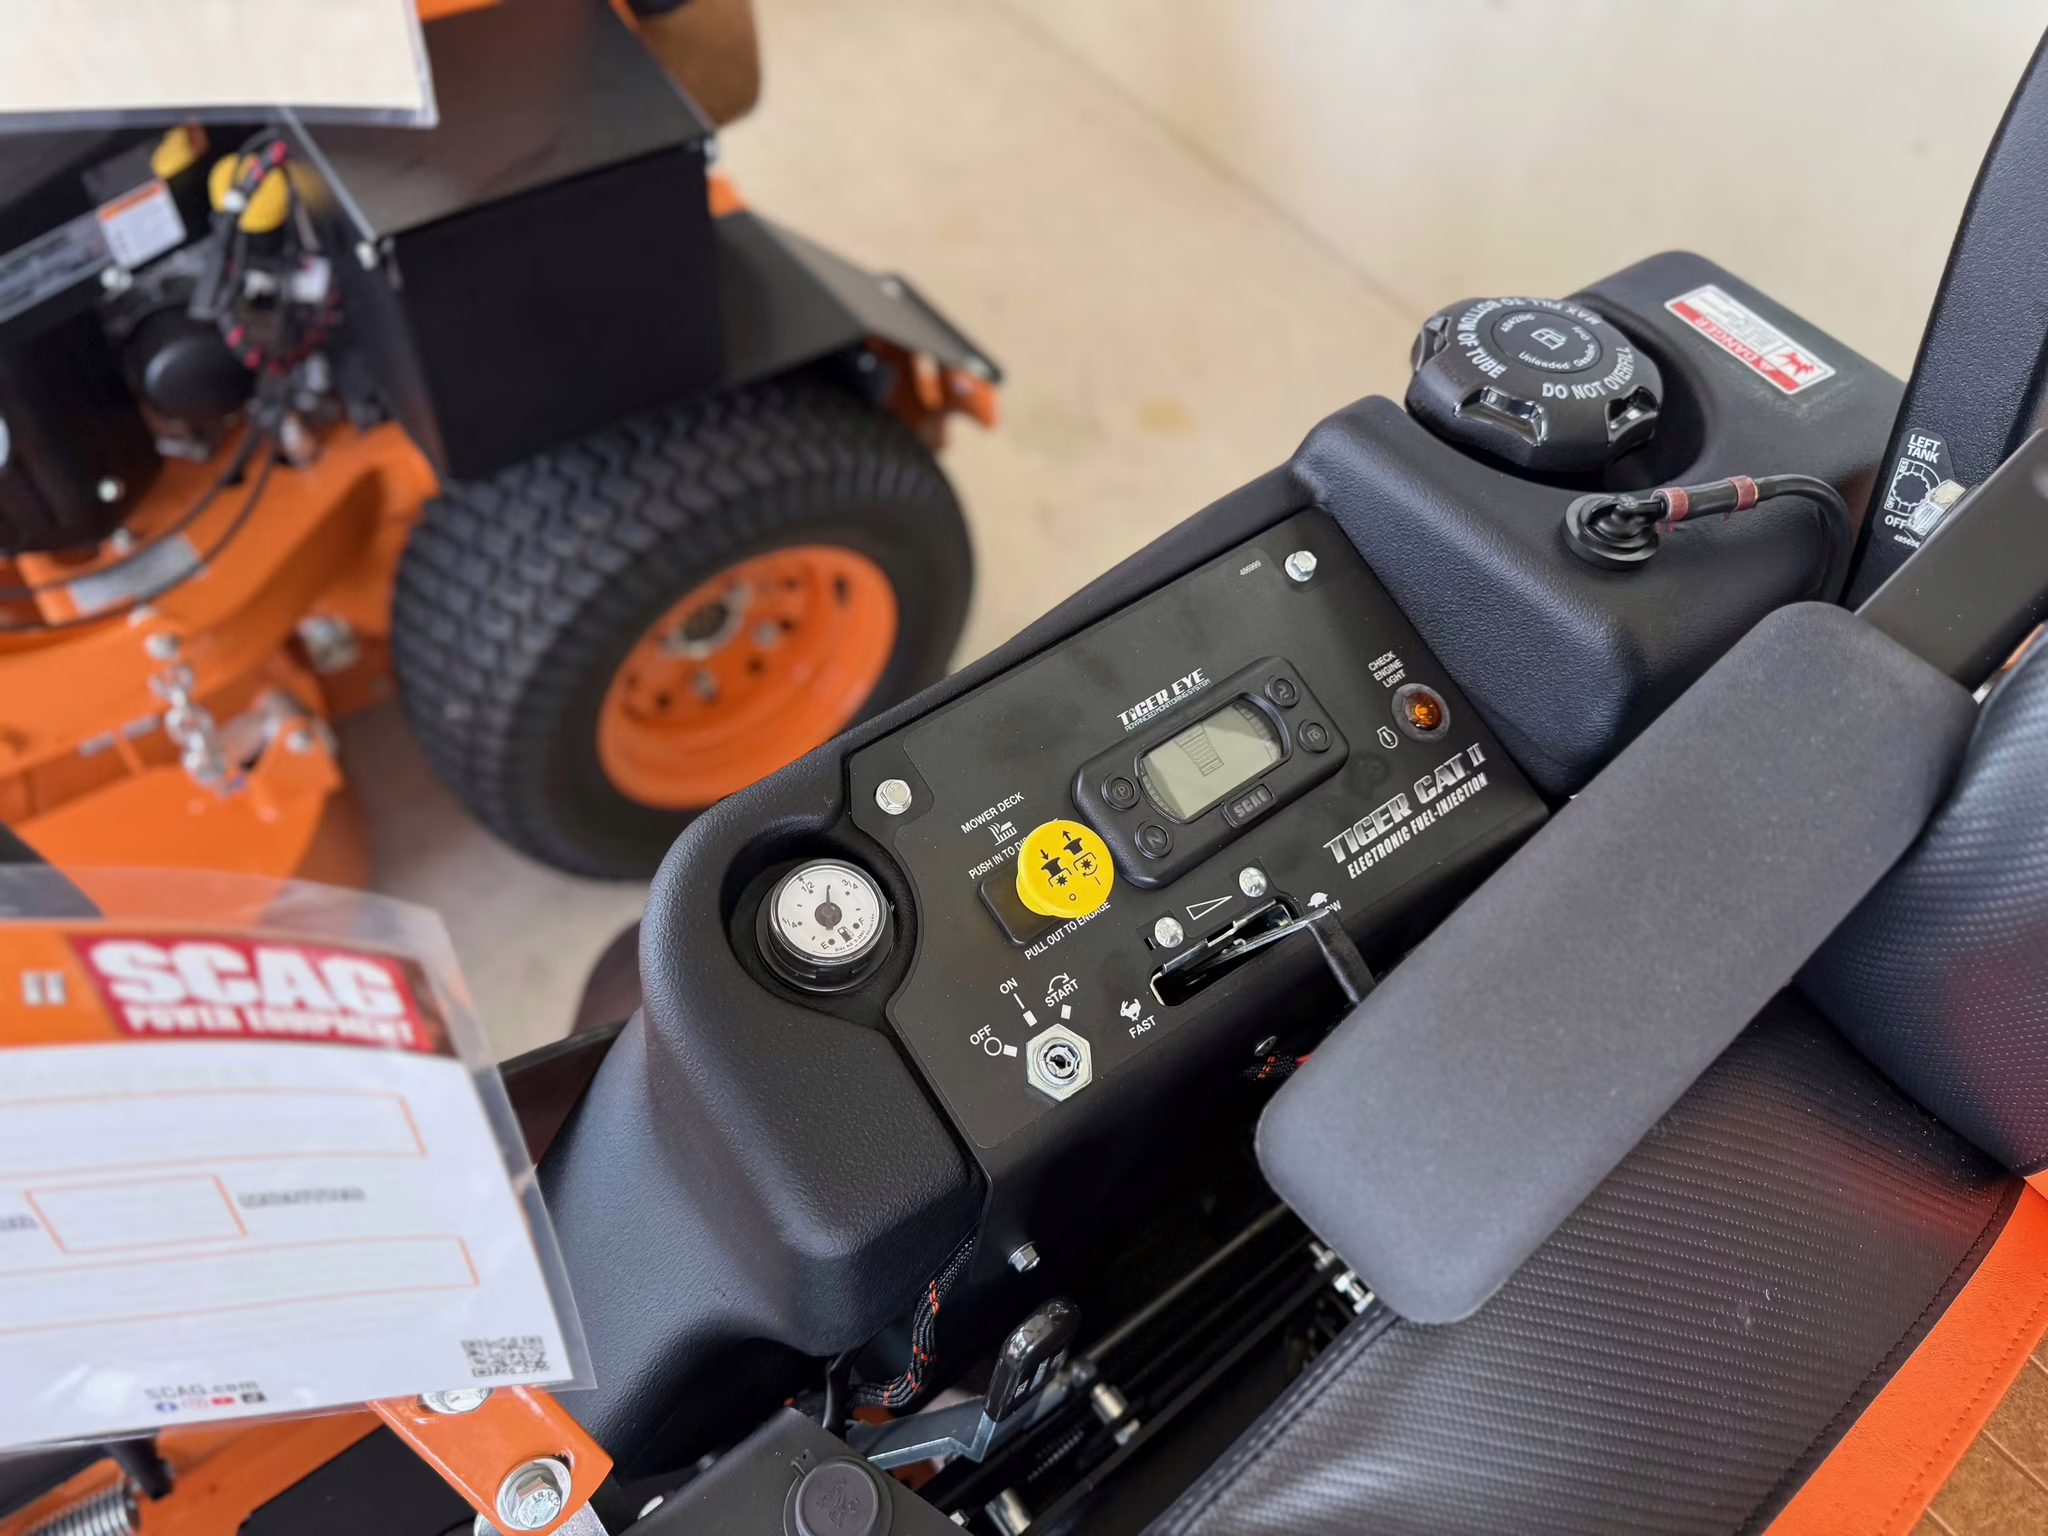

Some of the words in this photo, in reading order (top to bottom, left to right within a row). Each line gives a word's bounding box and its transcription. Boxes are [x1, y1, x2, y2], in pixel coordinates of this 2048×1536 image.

[1500, 298, 1526, 307] TO
[1531, 298, 1562, 311] FILL
[1457, 300, 1502, 332] BOTTOM
[1566, 306, 1602, 325] MAX
[1457, 332, 1480, 347] OF
[1694, 314, 1760, 363] DANGER
[1466, 346, 1508, 379] TUBE
[1518, 351, 1571, 370] Unleaded
[1541, 383, 1569, 399] DO
[1571, 383, 1606, 400] NOT
[1604, 347, 1634, 390] OVERFILL
[1907, 444, 1940, 463] TANK
[1908, 434, 1941, 452] LEFT
[1884, 515, 1908, 529] OFF
[1368, 650, 1397, 672] CHECK
[1373, 659, 1404, 682] ENGINE
[1382, 669, 1406, 688] LIGHT
[1117, 689, 1170, 727] TIGER
[1170, 667, 1206, 695] EYE
[1124, 709, 1157, 732] ADVANCED
[1154, 689, 1189, 716] MONITORING
[1184, 678, 1211, 697] SYSTEM
[960, 807, 999, 834] MOWER
[999, 792, 1025, 813] DECK
[1323, 792, 1414, 864] TIGER
[1413, 752, 1467, 805] CAT
[1466, 742, 1488, 768] II
[1347, 826, 1411, 880] ELECTRONIC
[1409, 772, 1489, 835] FUEL-INJECTION
[968, 859, 994, 880] PUSH
[993, 853, 1005, 866] IN
[1002, 845, 1017, 858] TO
[858, 917, 865, 926] F
[1024, 941, 1049, 961] PULL
[1046, 928, 1066, 946] OUT
[1063, 921, 1079, 935] TO
[1076, 901, 1111, 927] ENGAGE
[820, 941, 829, 950] E
[89, 940, 405, 1016] SCAG
[999, 977, 1018, 995] ON
[1044, 978, 1079, 1008] START
[122, 1004, 243, 1033] POWER
[245, 1005, 416, 1045] EQUIPMENT
[969, 1024, 993, 1046] OFF
[1129, 1015, 1157, 1039] FAST
